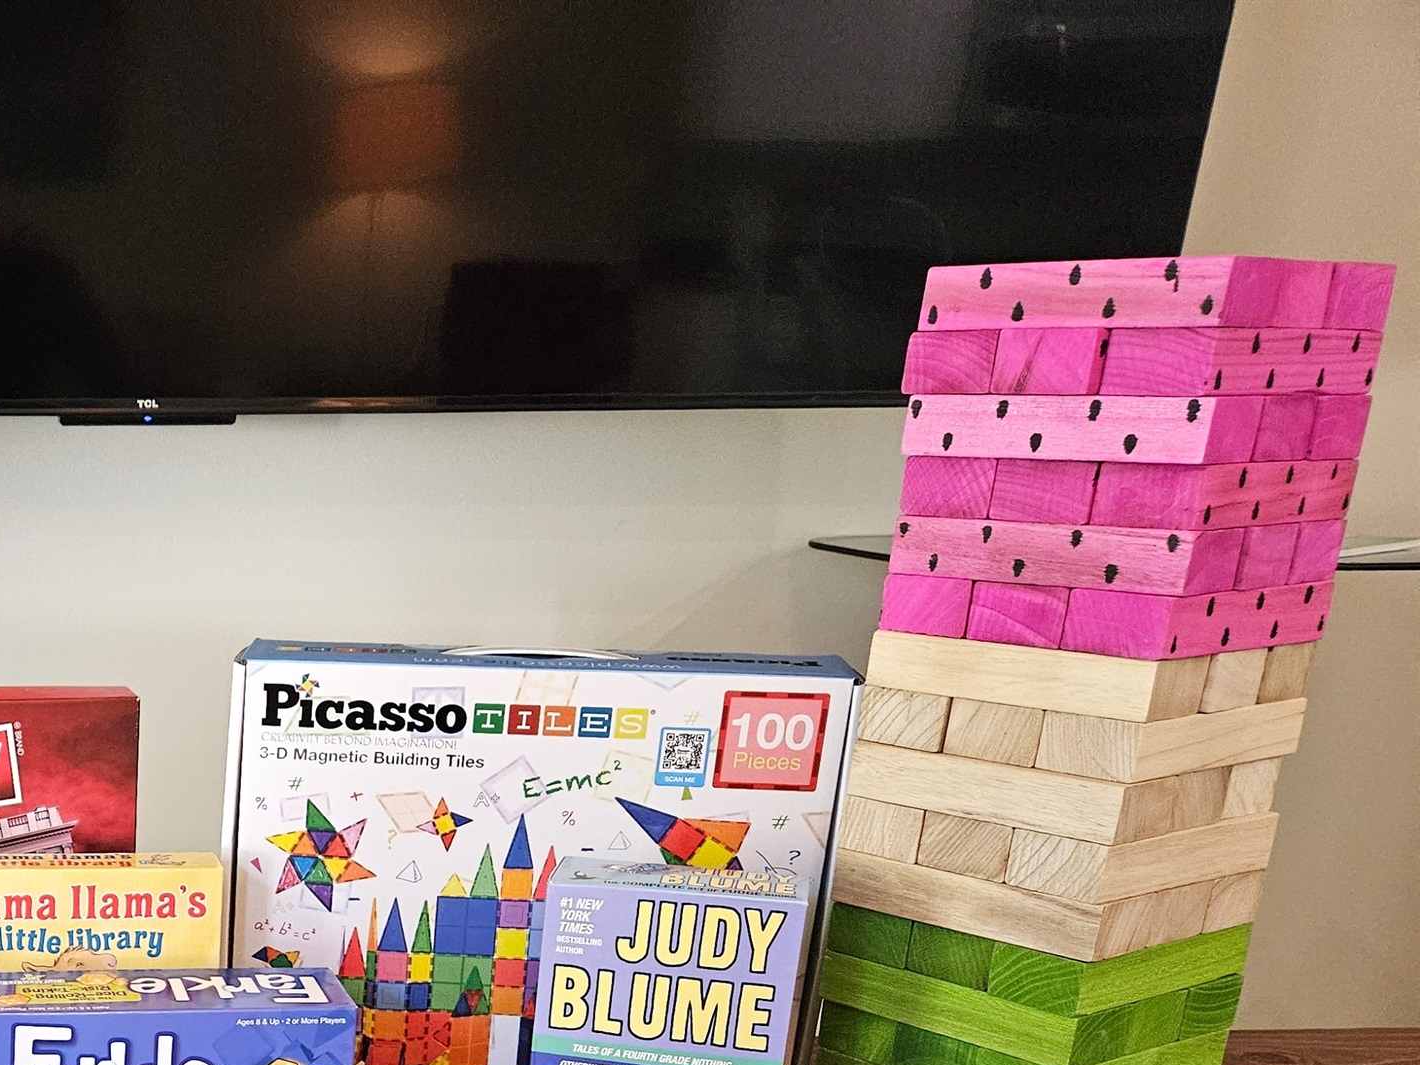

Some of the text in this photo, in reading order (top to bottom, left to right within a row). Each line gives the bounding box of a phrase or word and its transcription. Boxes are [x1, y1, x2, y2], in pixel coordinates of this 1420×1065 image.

[137, 400, 159, 408] TCL
[262, 682, 467, 733] Picasso
[475, 705, 646, 736] TILES
[732, 712, 814, 750] 100
[261, 731, 457, 750] CREATIVITY BEYOND IMAGINATION!
[259, 747, 485, 769] 3-D Magnetic Building Tiles
[732, 751, 801, 772] Pieces
[683, 776, 696, 784] ME
[70, 885, 207, 920] llama's
[560, 897, 603, 911] #1 NEW
[561, 909, 591, 922] YORK
[559, 922, 595, 935] TIMES
[616, 900, 787, 973] JUDY
[67, 928, 163, 957] library
[555, 945, 584, 955] AUTHOR
[556, 935, 602, 947] BESTSELLING
[548, 965, 776, 1051] BLUME
[320, 1017, 346, 1025] Players
[573, 1044, 599, 1055] TALES
[601, 1047, 613, 1056] OF
[614, 1049, 621, 1057] A
[623, 1050, 658, 1062] FOURTH
[659, 1054, 690, 1065] GRADE
